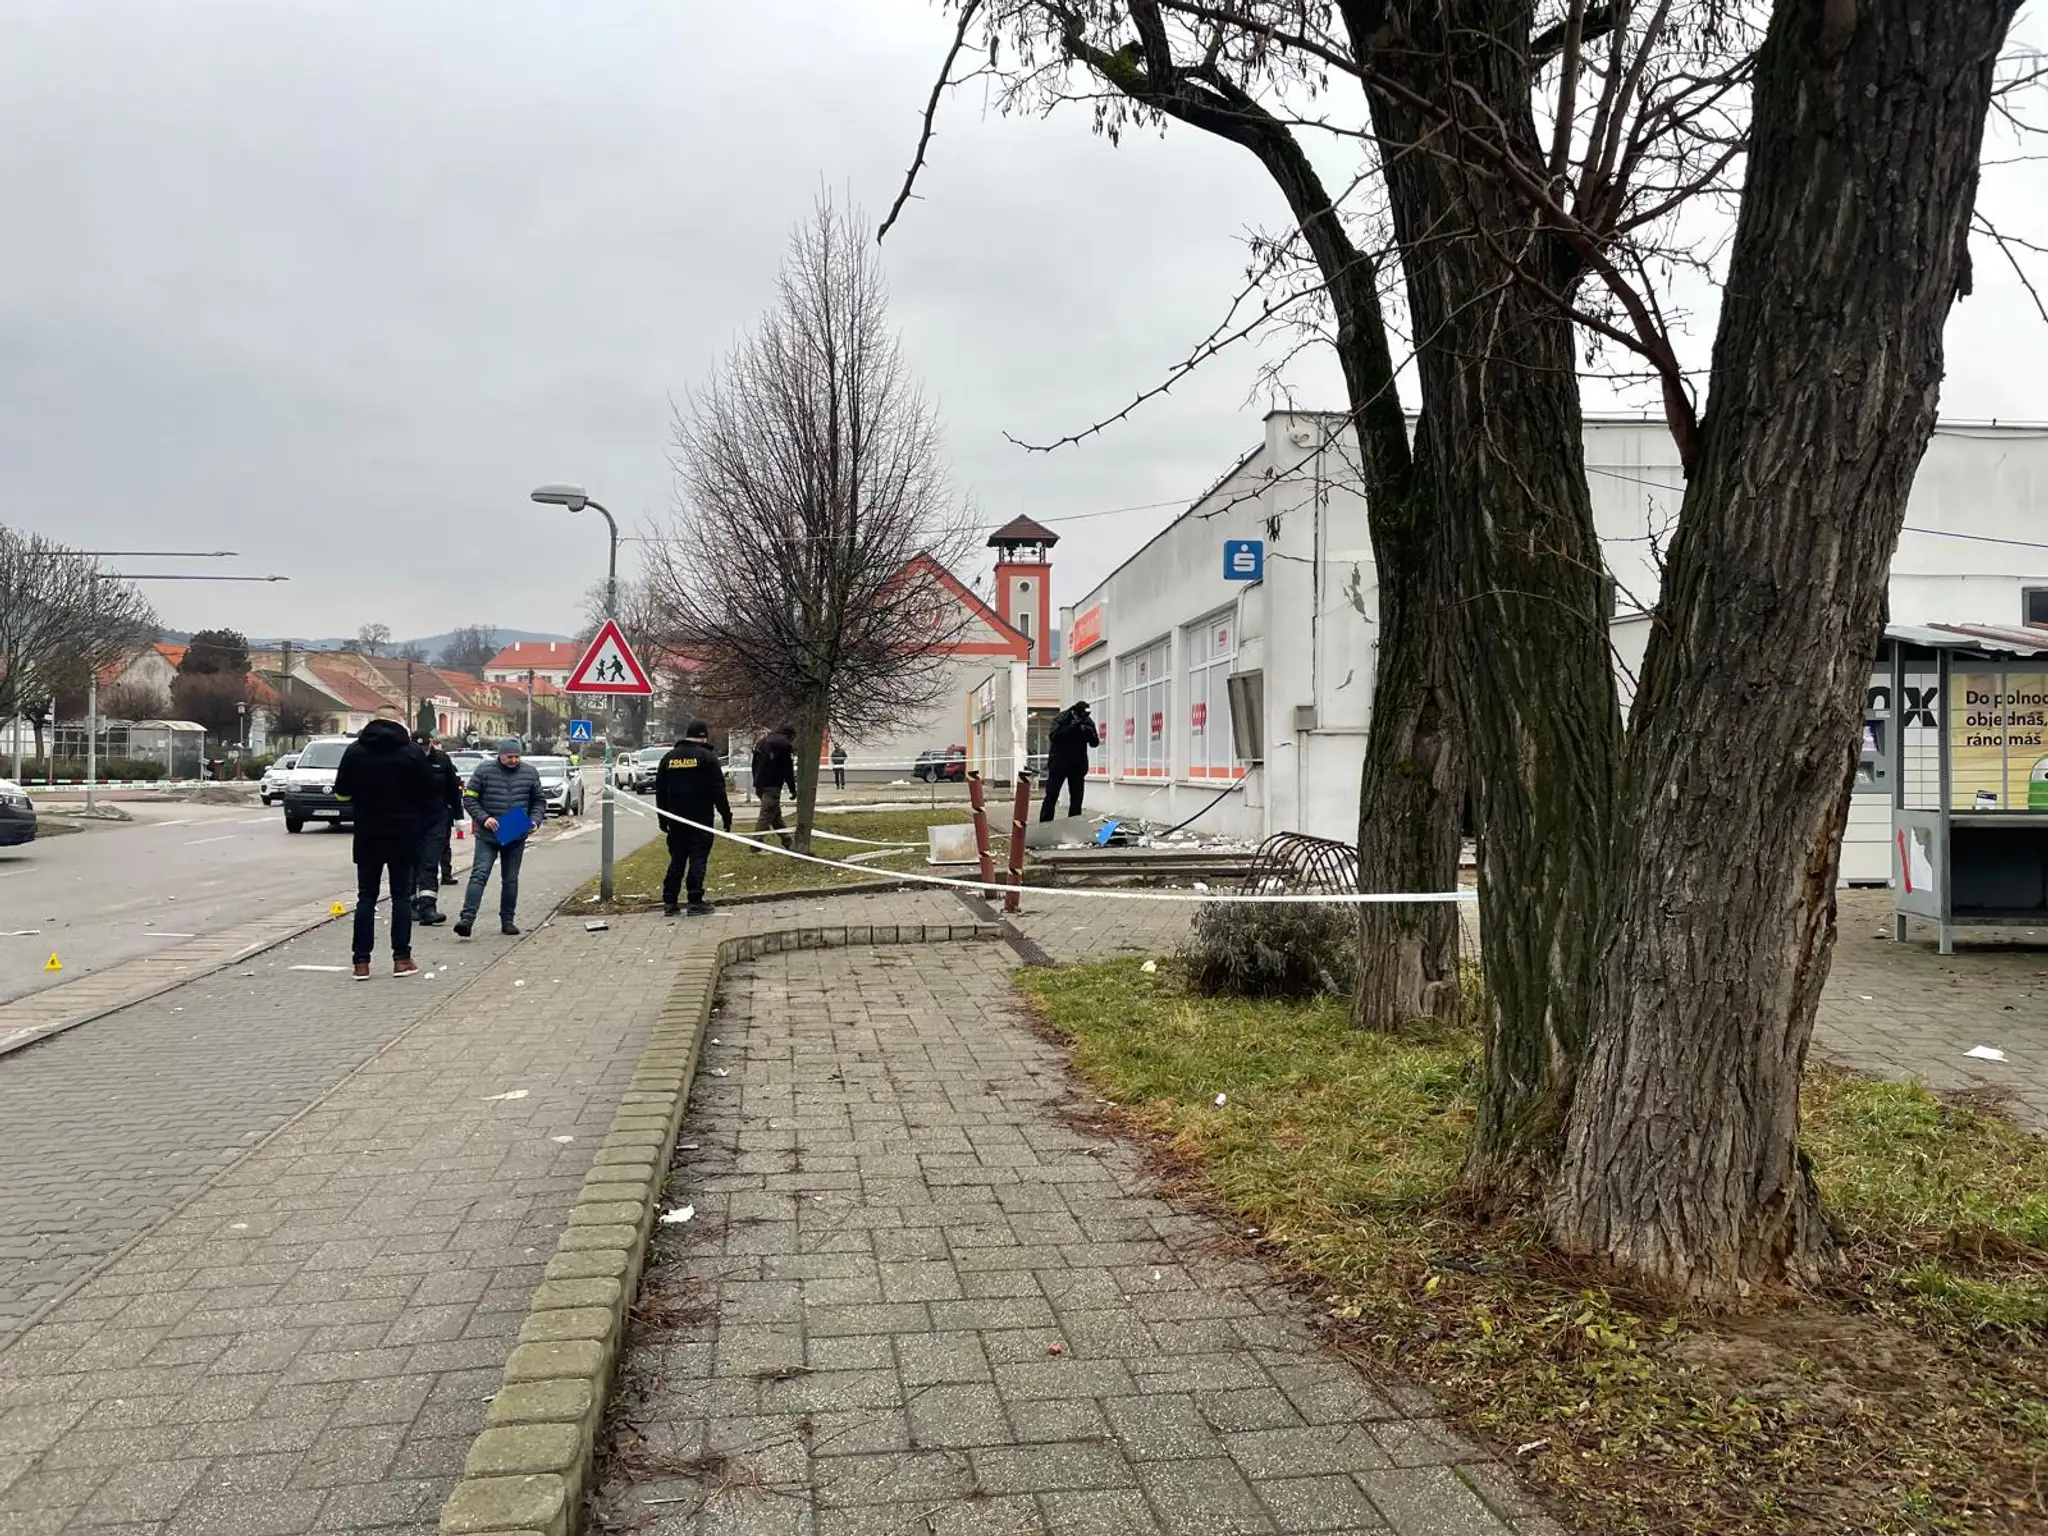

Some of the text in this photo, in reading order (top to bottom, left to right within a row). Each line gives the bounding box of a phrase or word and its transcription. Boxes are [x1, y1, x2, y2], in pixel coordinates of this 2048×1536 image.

[1966, 690, 1990, 705] Do
[1966, 711, 2048, 730] objednáš,
[1966, 732, 2042, 746] ráno máš
